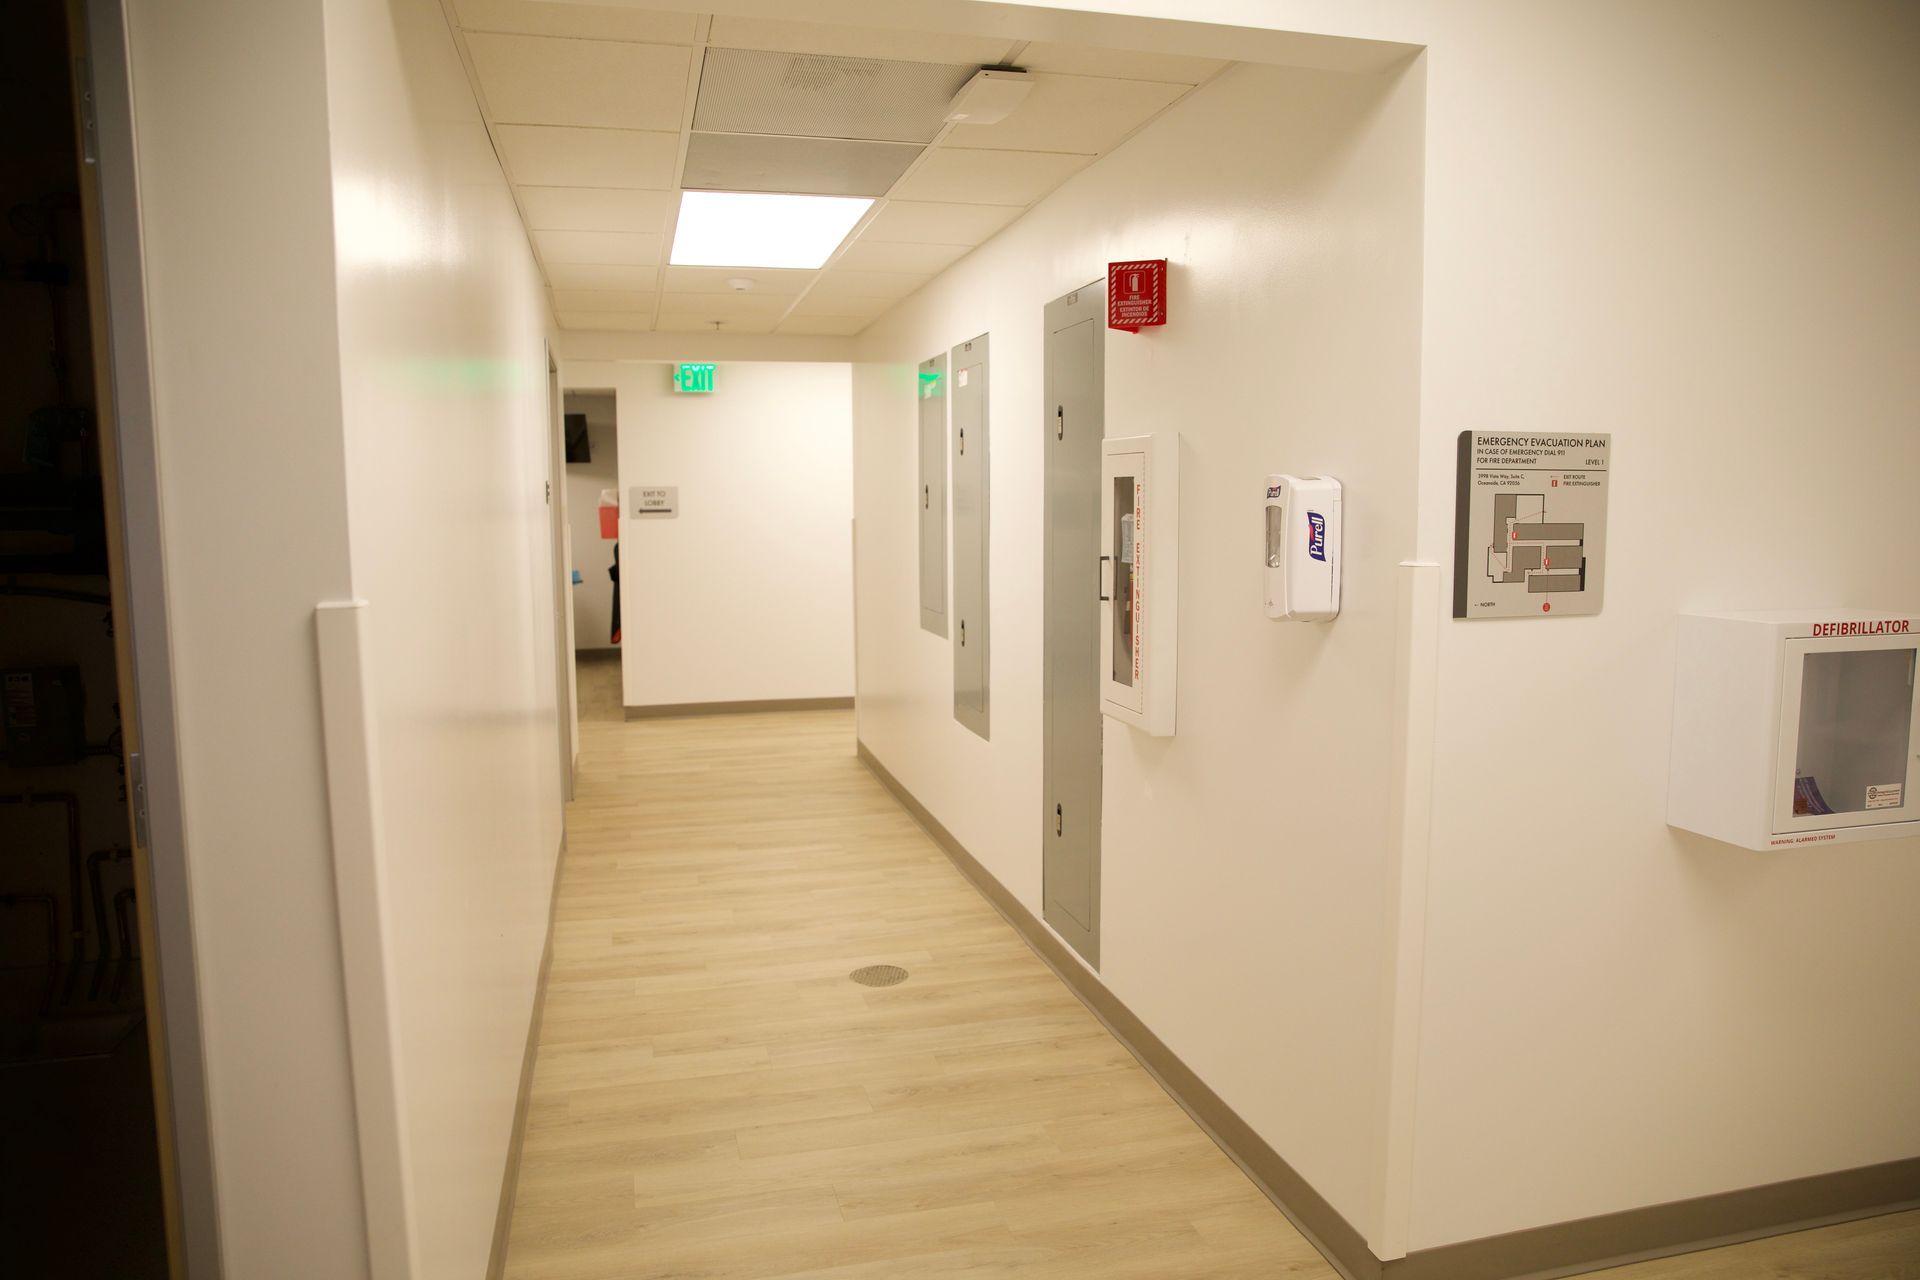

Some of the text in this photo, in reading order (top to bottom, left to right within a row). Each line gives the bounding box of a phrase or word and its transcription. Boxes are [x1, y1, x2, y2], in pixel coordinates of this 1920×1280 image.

[680, 364, 715, 392] EXIT
[1477, 437, 1606, 448] EMERGENCY EVACUATION PLAN
[1310, 516, 1324, 556] Purell
[1813, 620, 1910, 636] DEFIBRILLATOR
